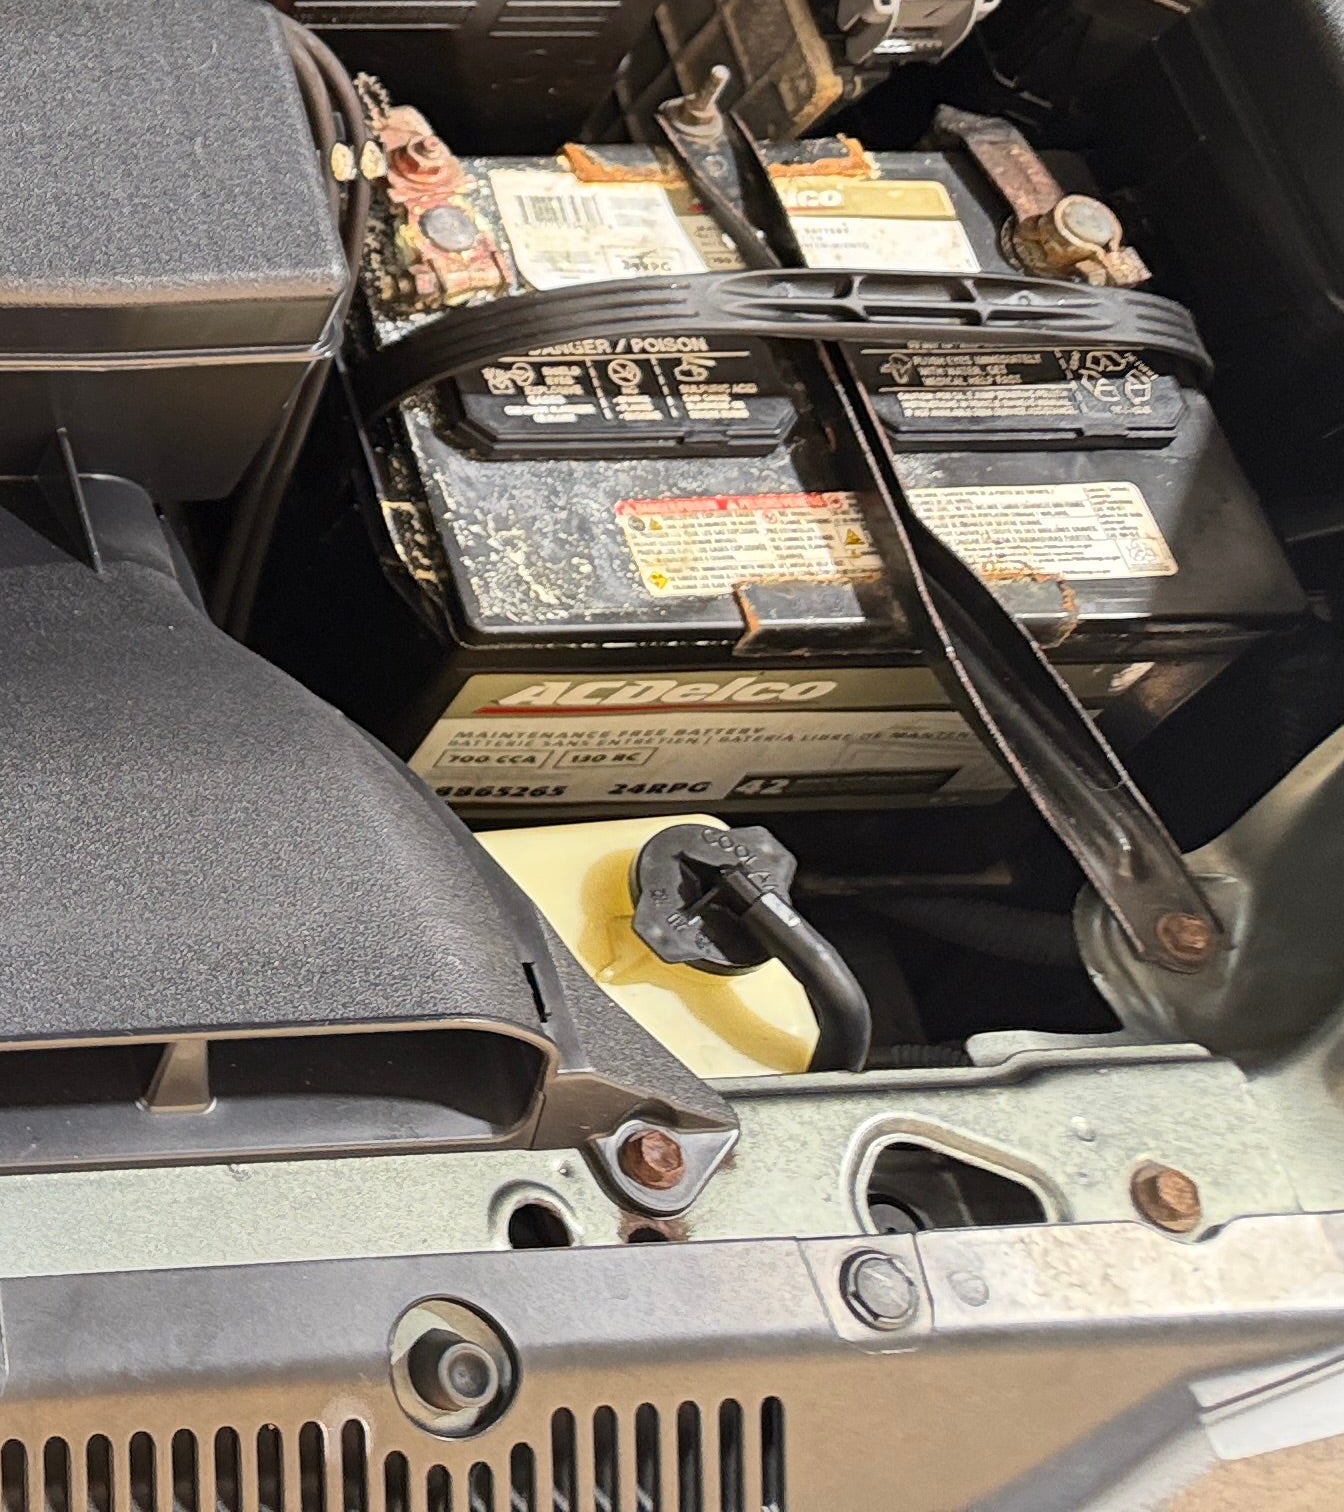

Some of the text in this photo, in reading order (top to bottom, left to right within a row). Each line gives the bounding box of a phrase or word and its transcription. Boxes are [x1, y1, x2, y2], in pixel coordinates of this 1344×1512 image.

[528, 338, 612, 355] ANGER
[630, 336, 709, 353] POISON
[498, 676, 838, 706] ACDelco
[454, 727, 766, 740] MAINTENANCE FREE BATTERY
[447, 738, 534, 748] BATTERIE
[543, 738, 590, 748] SANS
[447, 753, 537, 765] 700 CCA
[608, 780, 712, 796] 24RPG
[733, 778, 790, 795] 42
